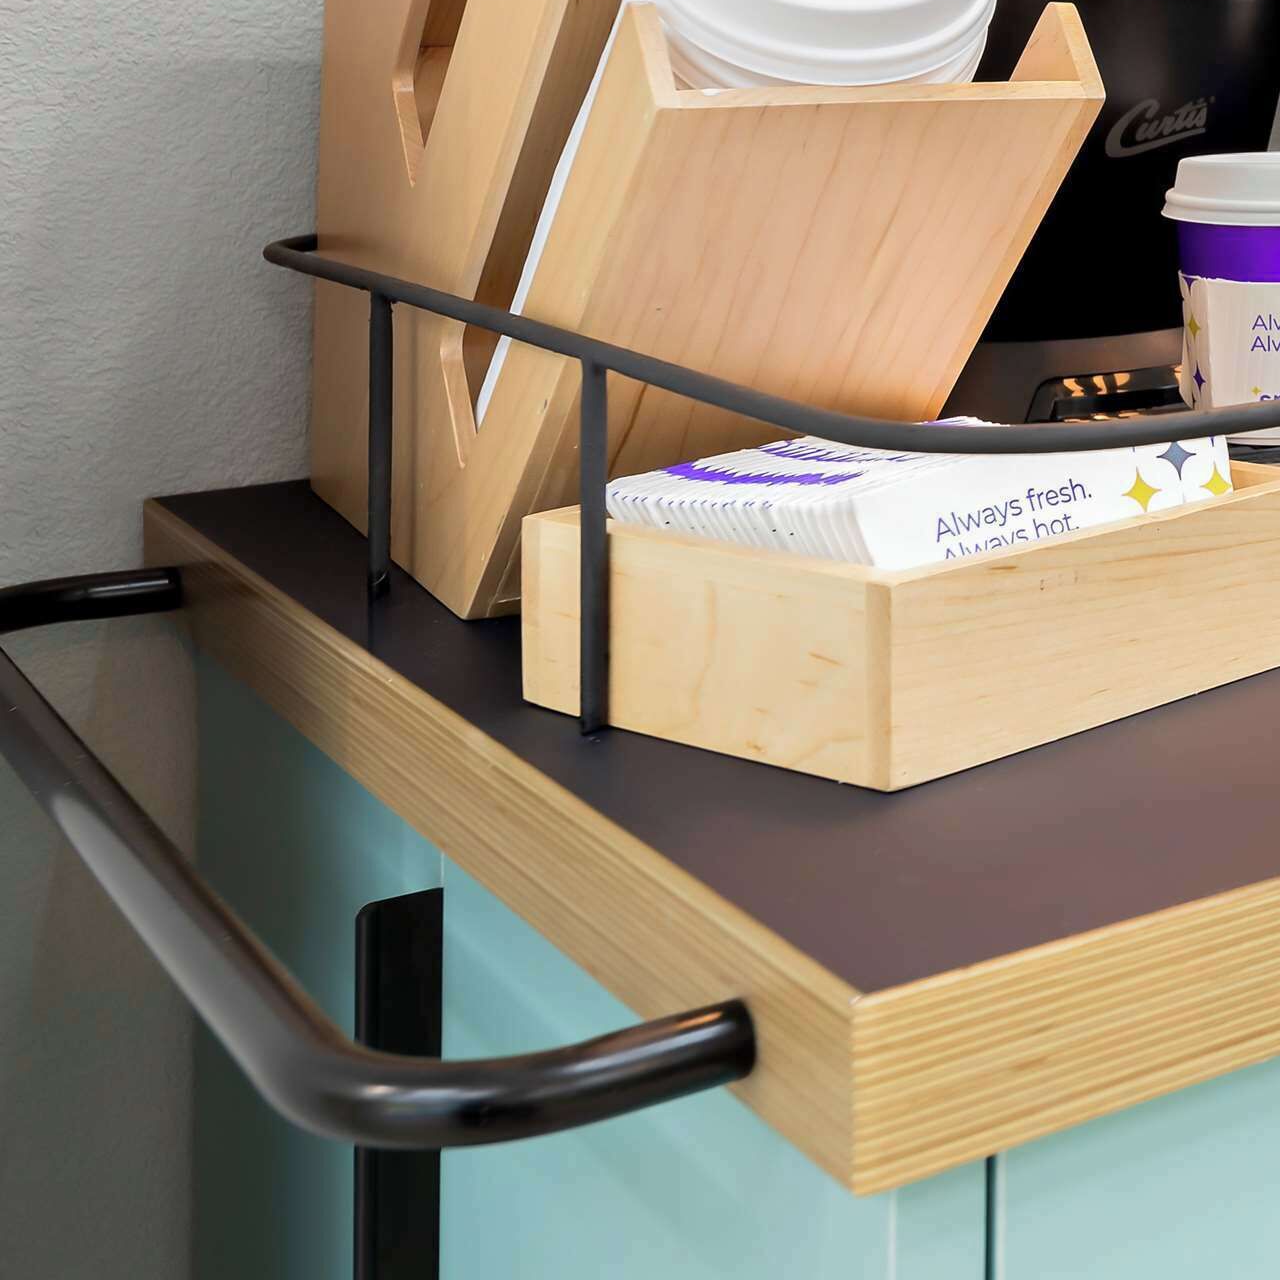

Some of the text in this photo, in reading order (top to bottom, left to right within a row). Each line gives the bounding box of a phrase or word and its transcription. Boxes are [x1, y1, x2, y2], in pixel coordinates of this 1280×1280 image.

[1104, 96, 1207, 158] Curtis
[936, 478, 1092, 543] Always fresh.
[1033, 513, 1080, 539] hot.
